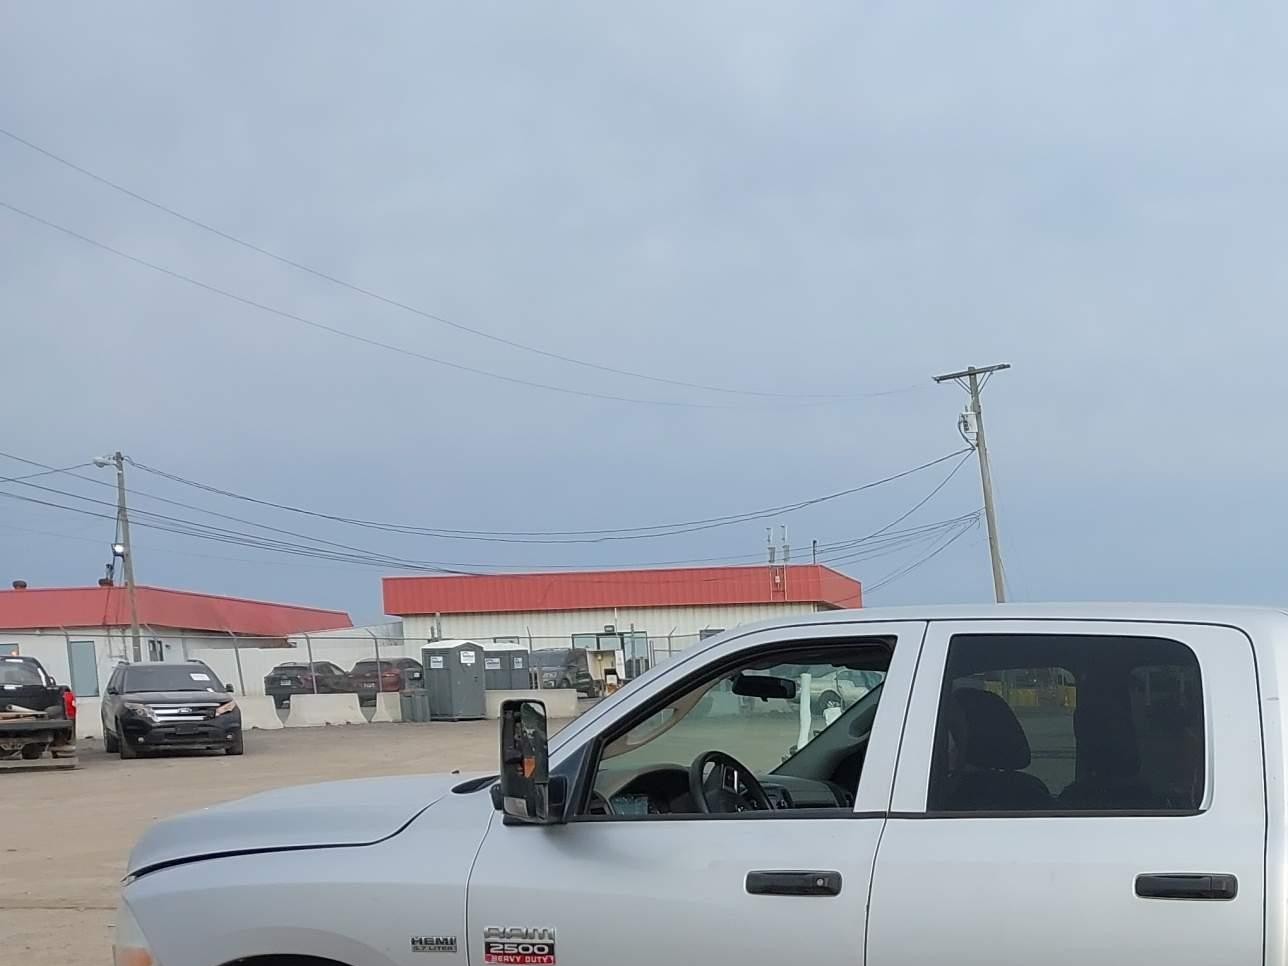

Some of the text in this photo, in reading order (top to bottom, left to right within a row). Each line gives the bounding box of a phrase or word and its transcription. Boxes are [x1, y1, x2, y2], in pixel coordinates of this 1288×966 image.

[484, 926, 556, 941] RAM
[411, 936, 457, 946] HEMI
[490, 943, 549, 954] 2500
[491, 955, 550, 963] HEAVY DUTY
